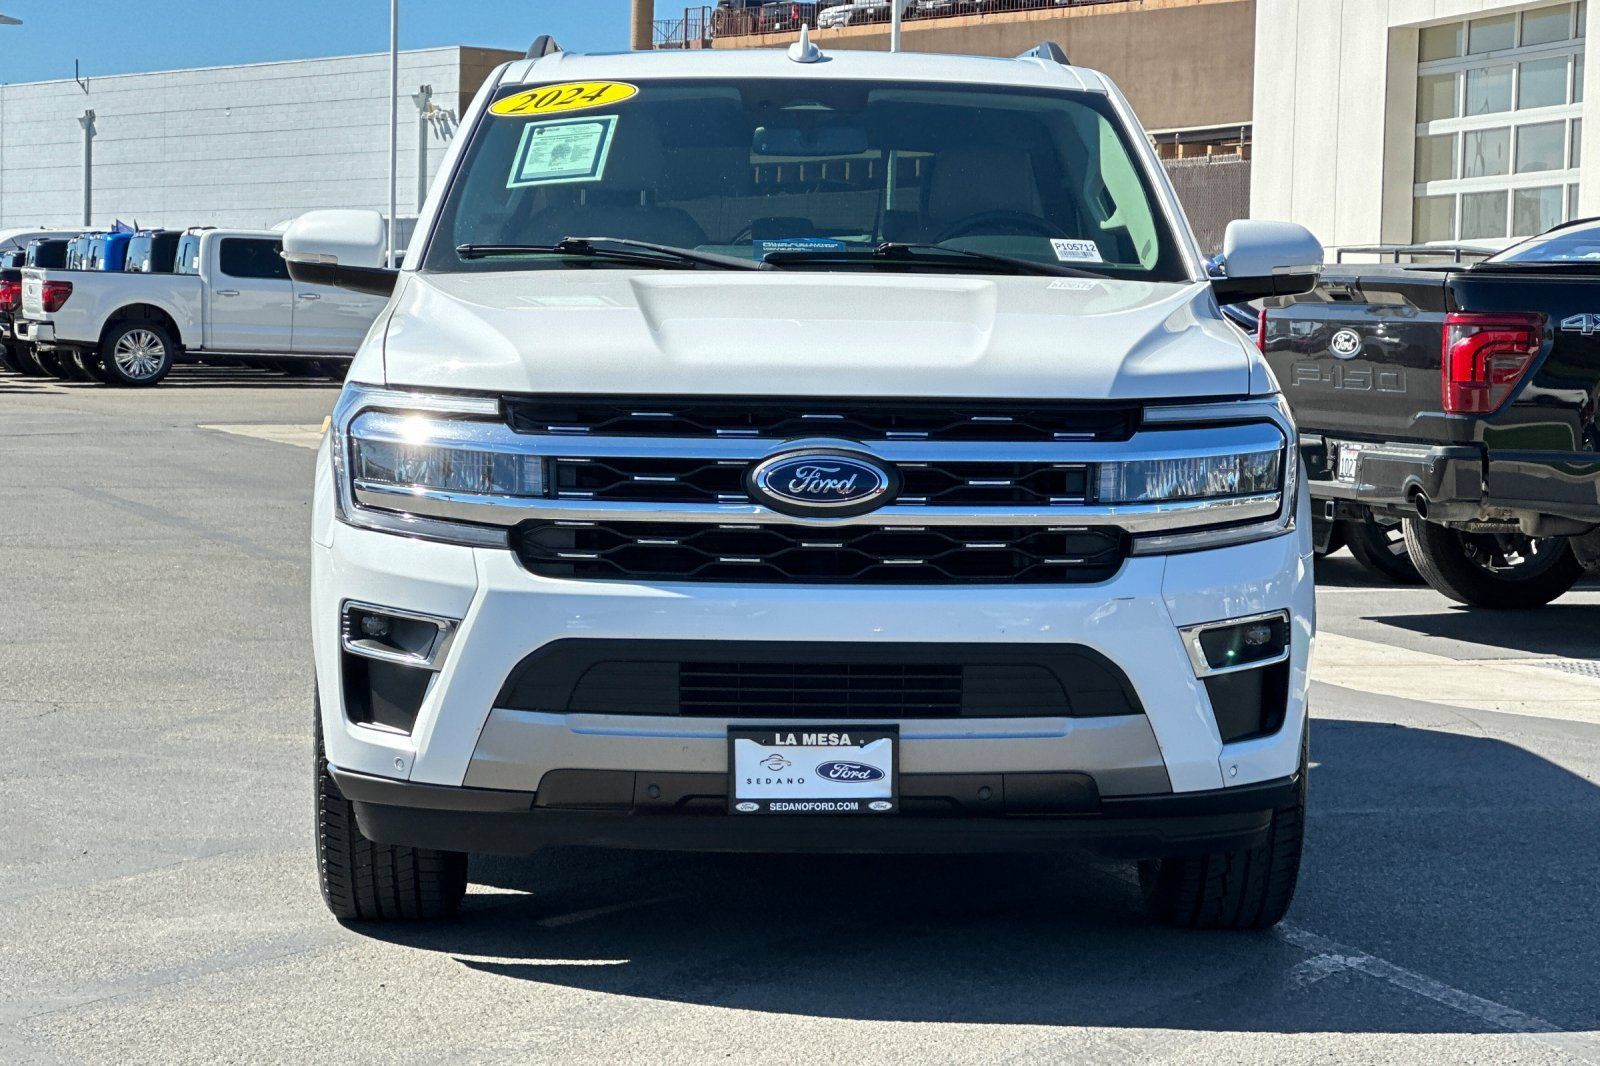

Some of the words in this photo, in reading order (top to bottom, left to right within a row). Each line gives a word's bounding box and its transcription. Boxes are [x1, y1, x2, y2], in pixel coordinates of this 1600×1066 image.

[507, 84, 613, 113] 2024
[1055, 242, 1097, 252] P105712
[1335, 333, 1356, 351] Ford
[1290, 360, 1407, 393] F-150
[788, 465, 858, 495] Ford
[775, 733, 797, 746] LA
[802, 733, 852, 746] MESA
[829, 763, 870, 780] Ford
[746, 777, 805, 785] SEDANO
[769, 802, 859, 811] SEDANOFORD.COM
